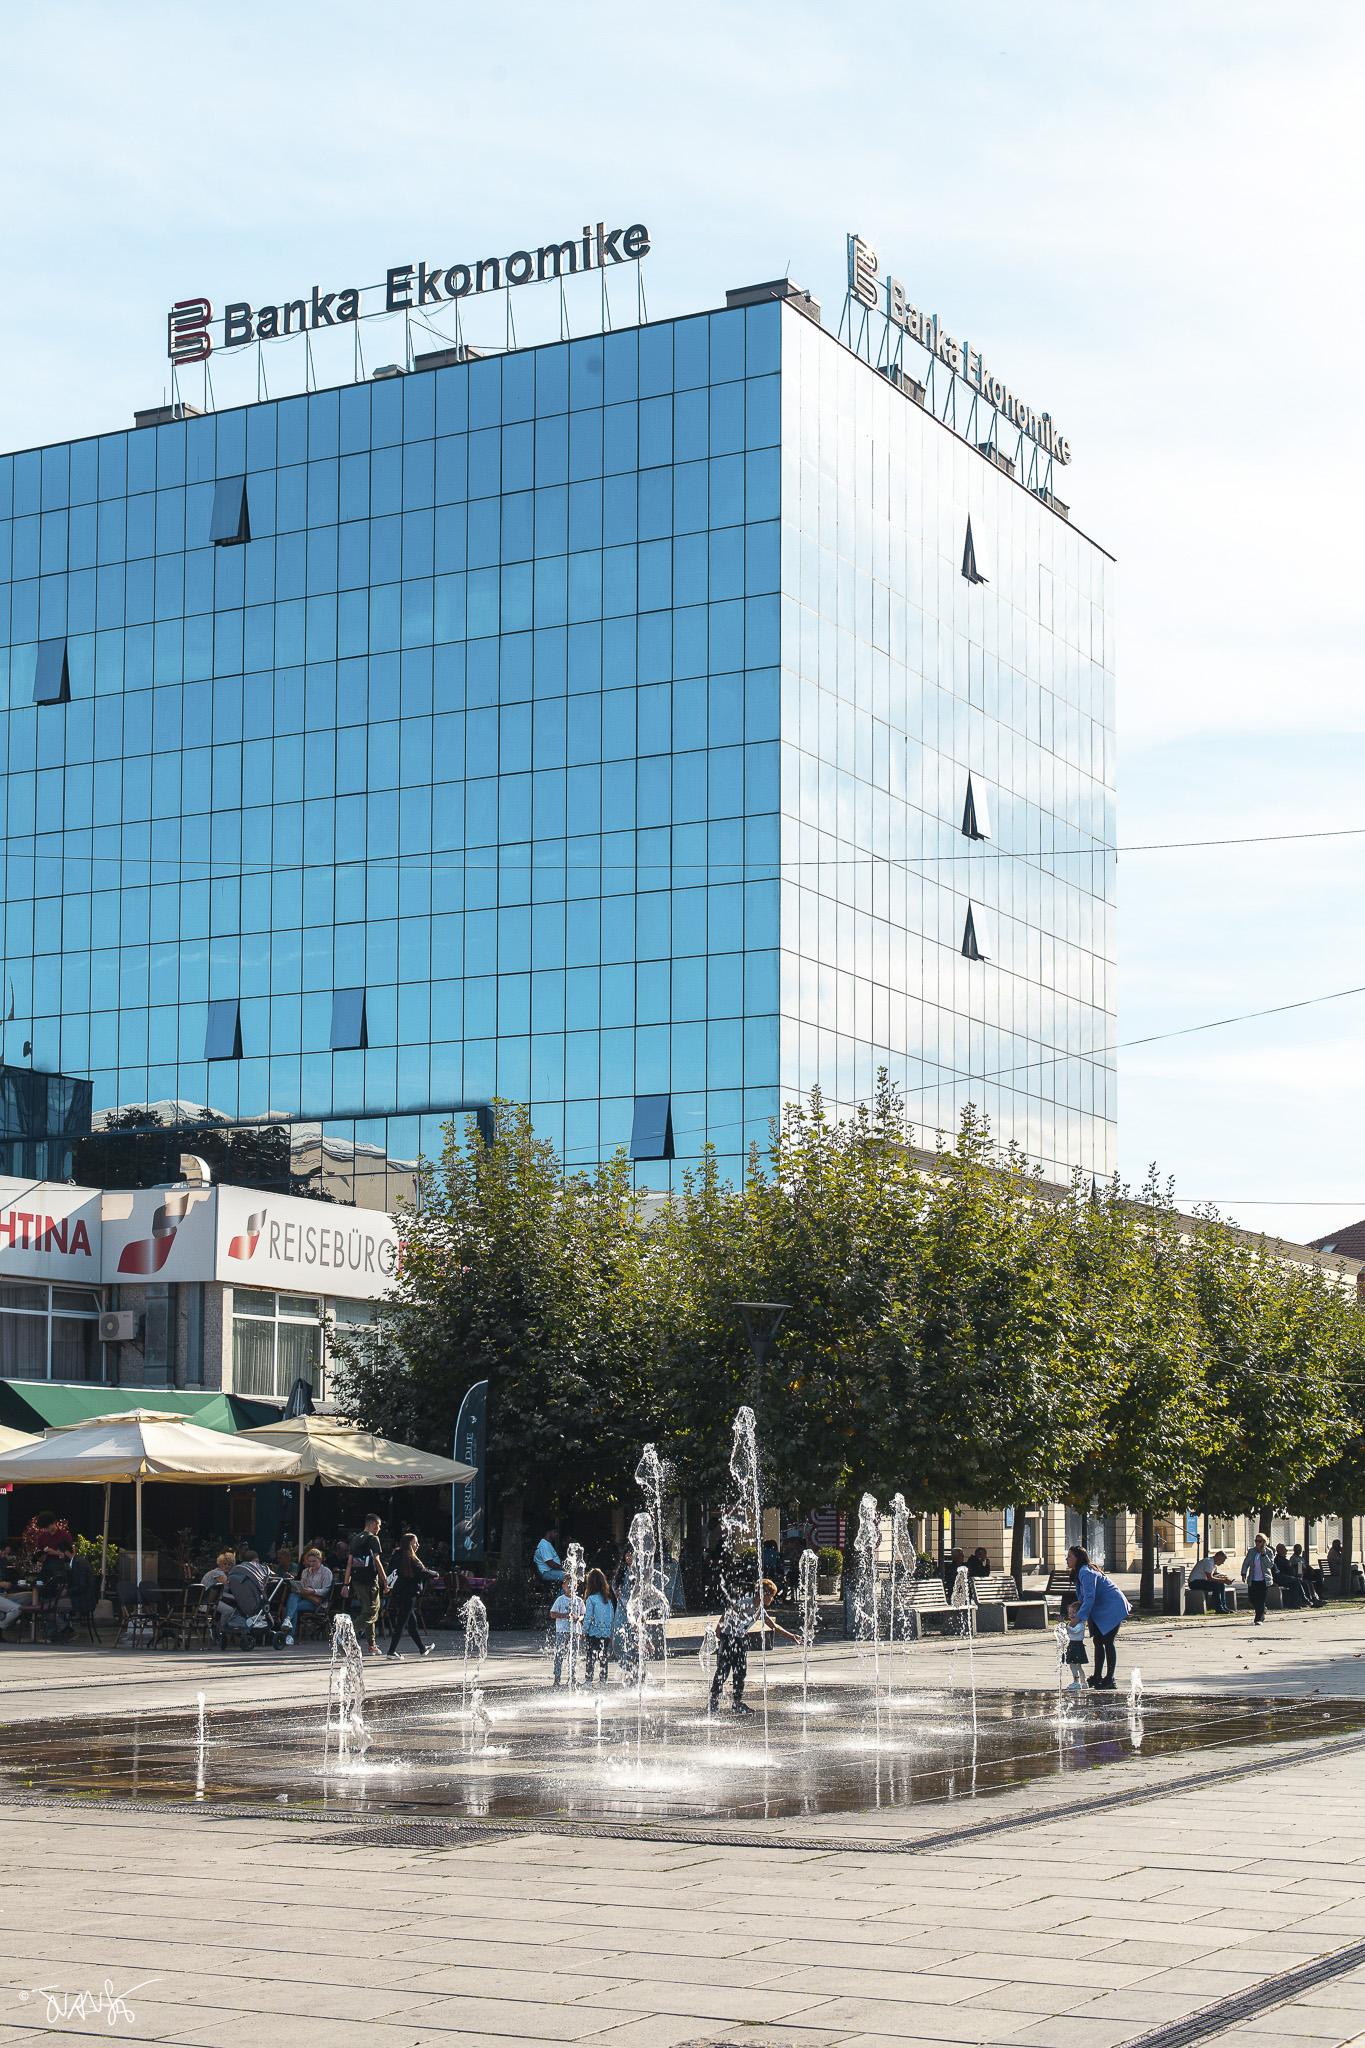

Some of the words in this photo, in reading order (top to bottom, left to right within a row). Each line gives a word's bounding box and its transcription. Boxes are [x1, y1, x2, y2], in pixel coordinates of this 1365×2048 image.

[224, 285, 361, 348] Banka
[386, 221, 651, 312] Ekonomike
[886, 275, 961, 374] Banka
[963, 341, 1073, 466] Ekonomike
[269, 1219, 395, 1275] REISEBÜRO
